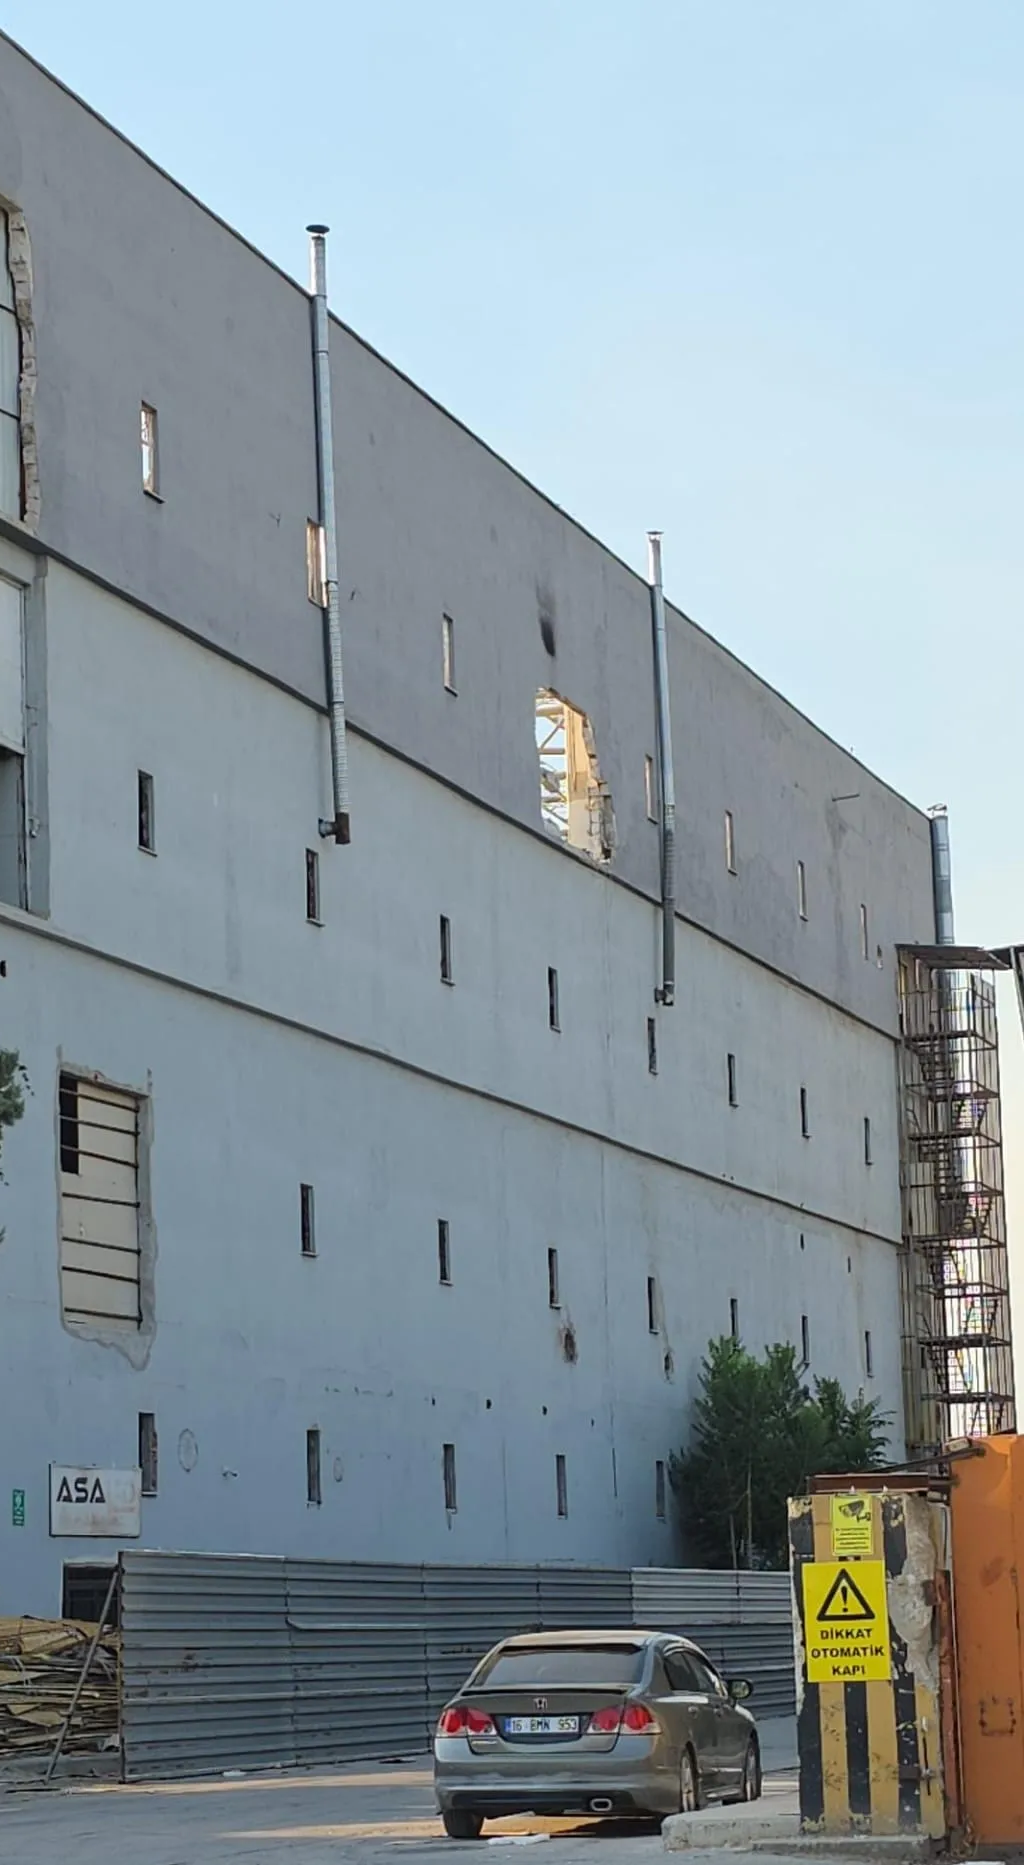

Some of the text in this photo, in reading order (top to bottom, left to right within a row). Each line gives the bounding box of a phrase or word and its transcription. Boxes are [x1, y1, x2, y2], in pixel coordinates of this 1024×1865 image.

[56, 1476, 106, 1503] ASA
[820, 1627, 873, 1640] DİKKAT
[811, 1644, 885, 1659] OTOMATİK
[832, 1665, 866, 1676] KAPI
